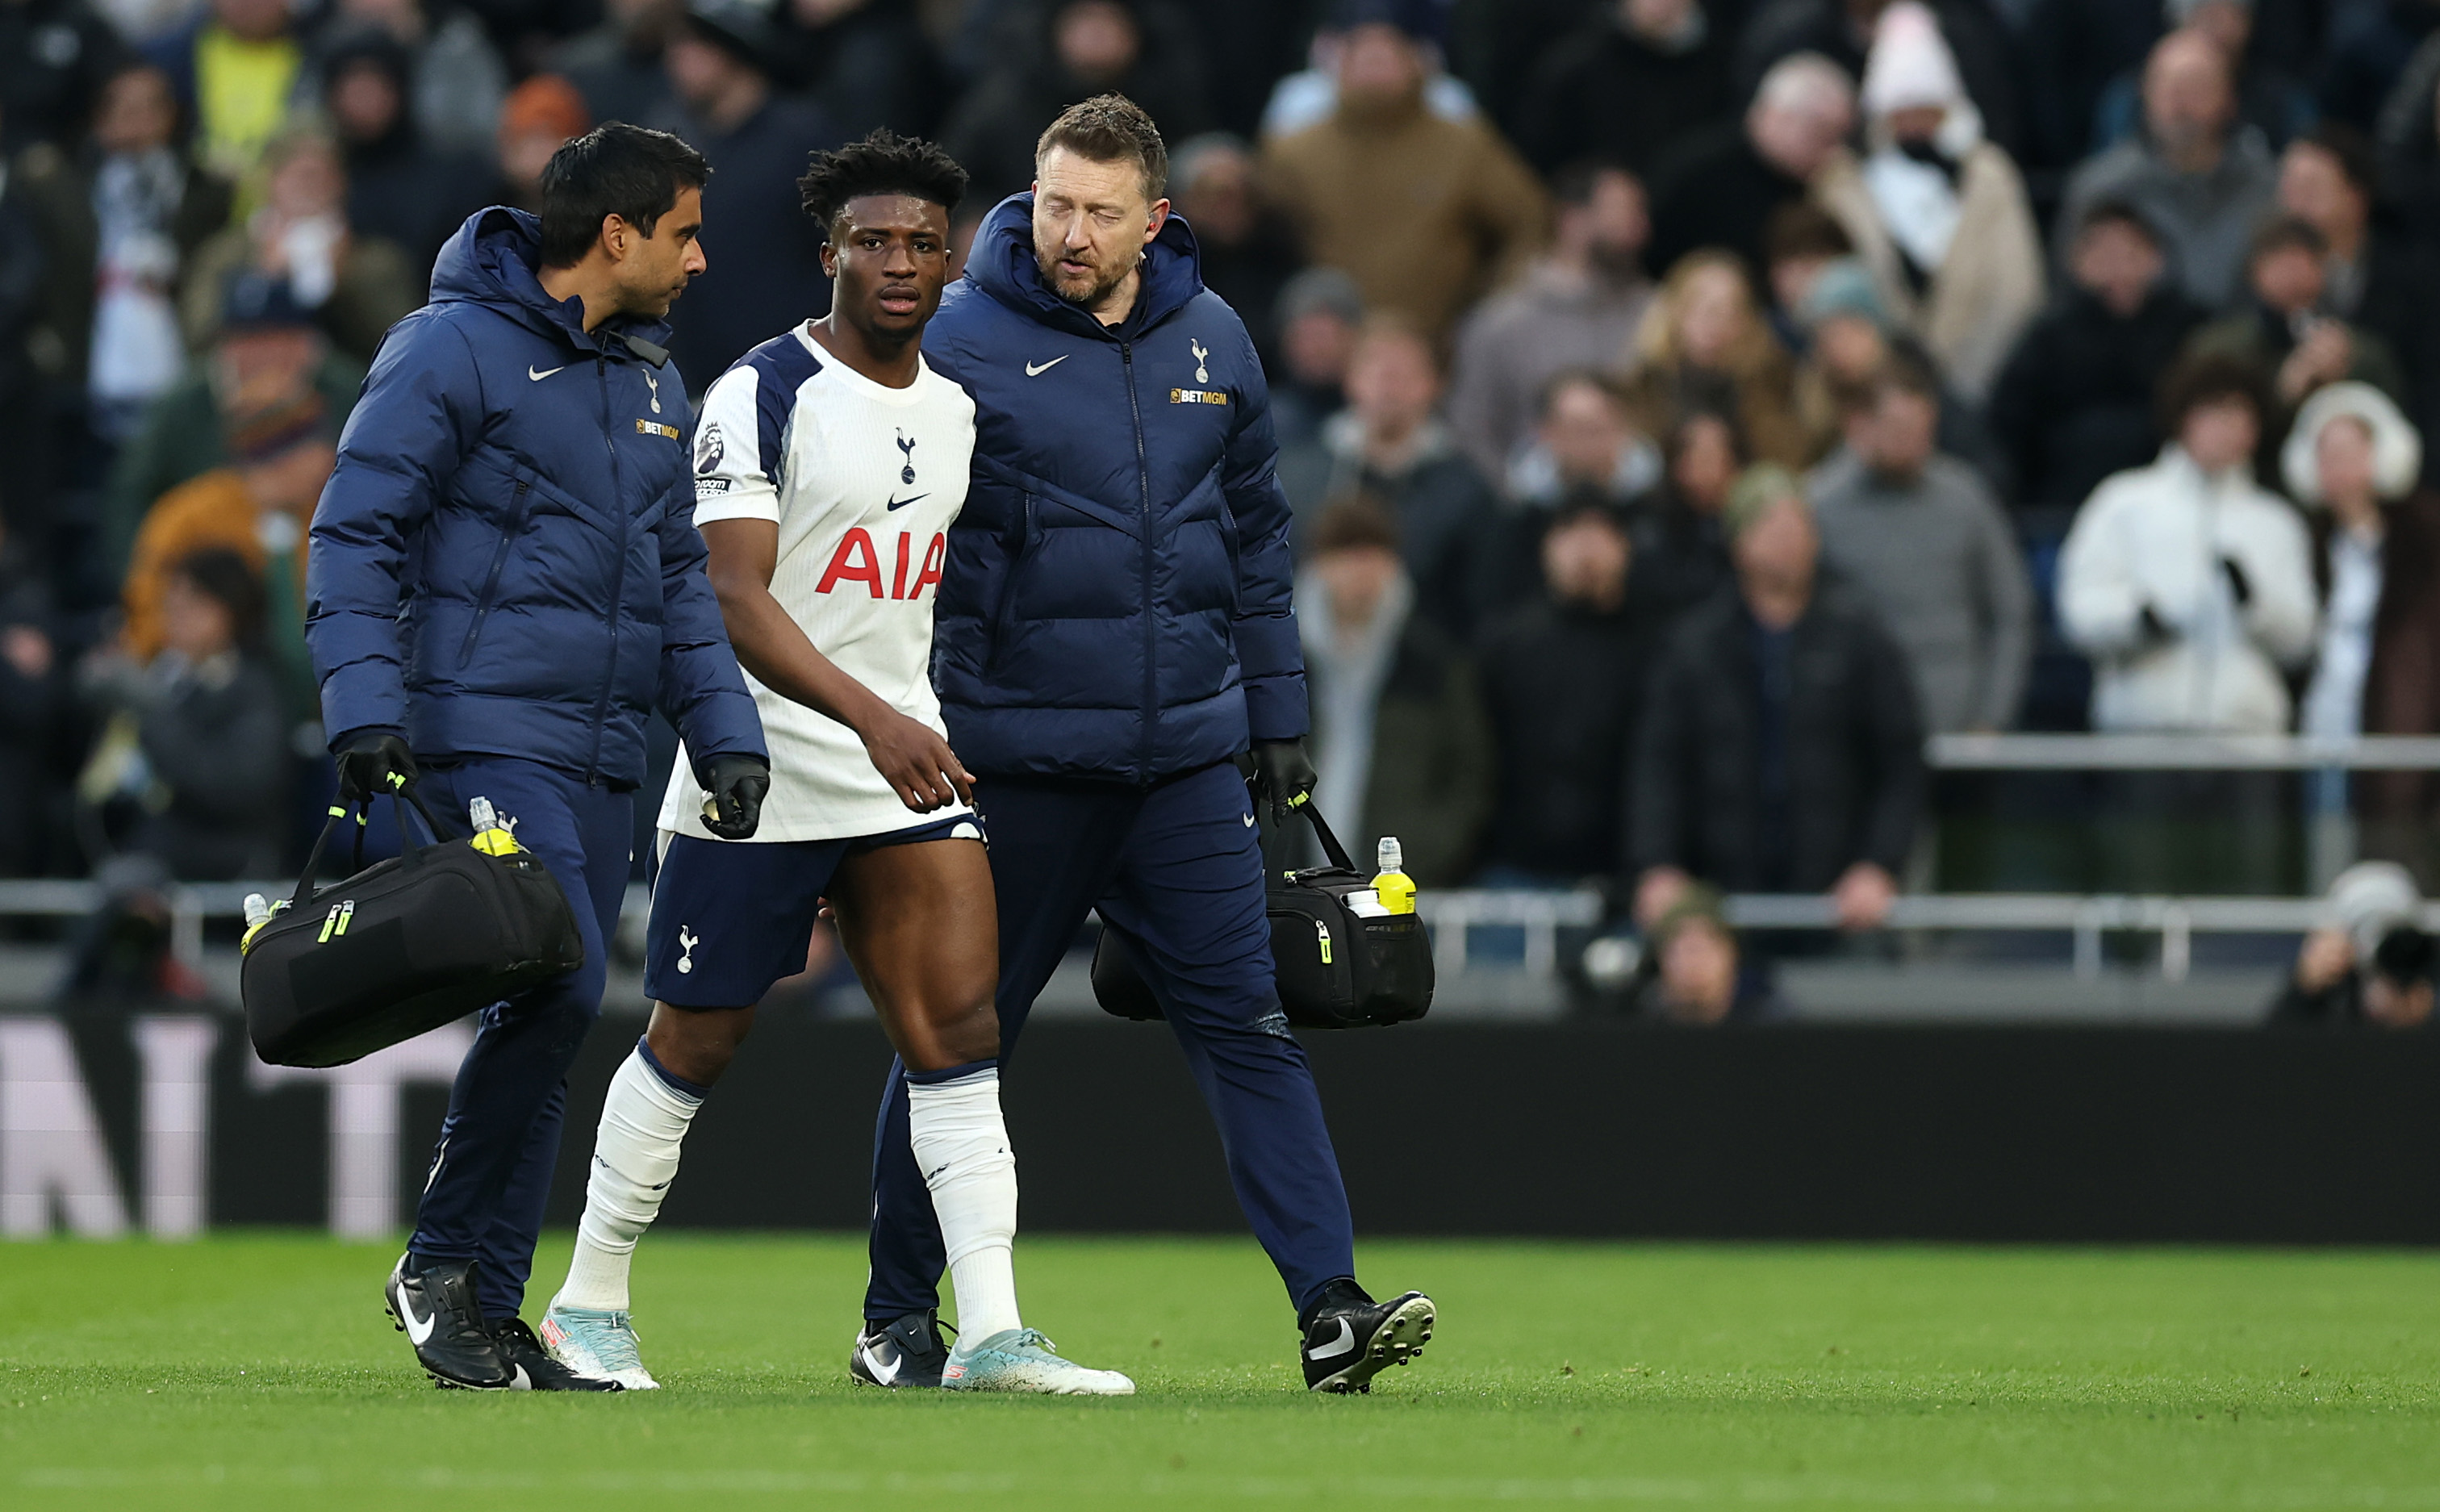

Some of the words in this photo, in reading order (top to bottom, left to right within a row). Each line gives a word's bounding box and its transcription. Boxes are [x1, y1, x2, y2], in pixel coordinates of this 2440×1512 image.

[1180, 390, 1227, 406] BETMGM
[645, 421, 679, 441] BETMGM
[700, 479, 726, 489] room
[814, 526, 945, 600] AIA
